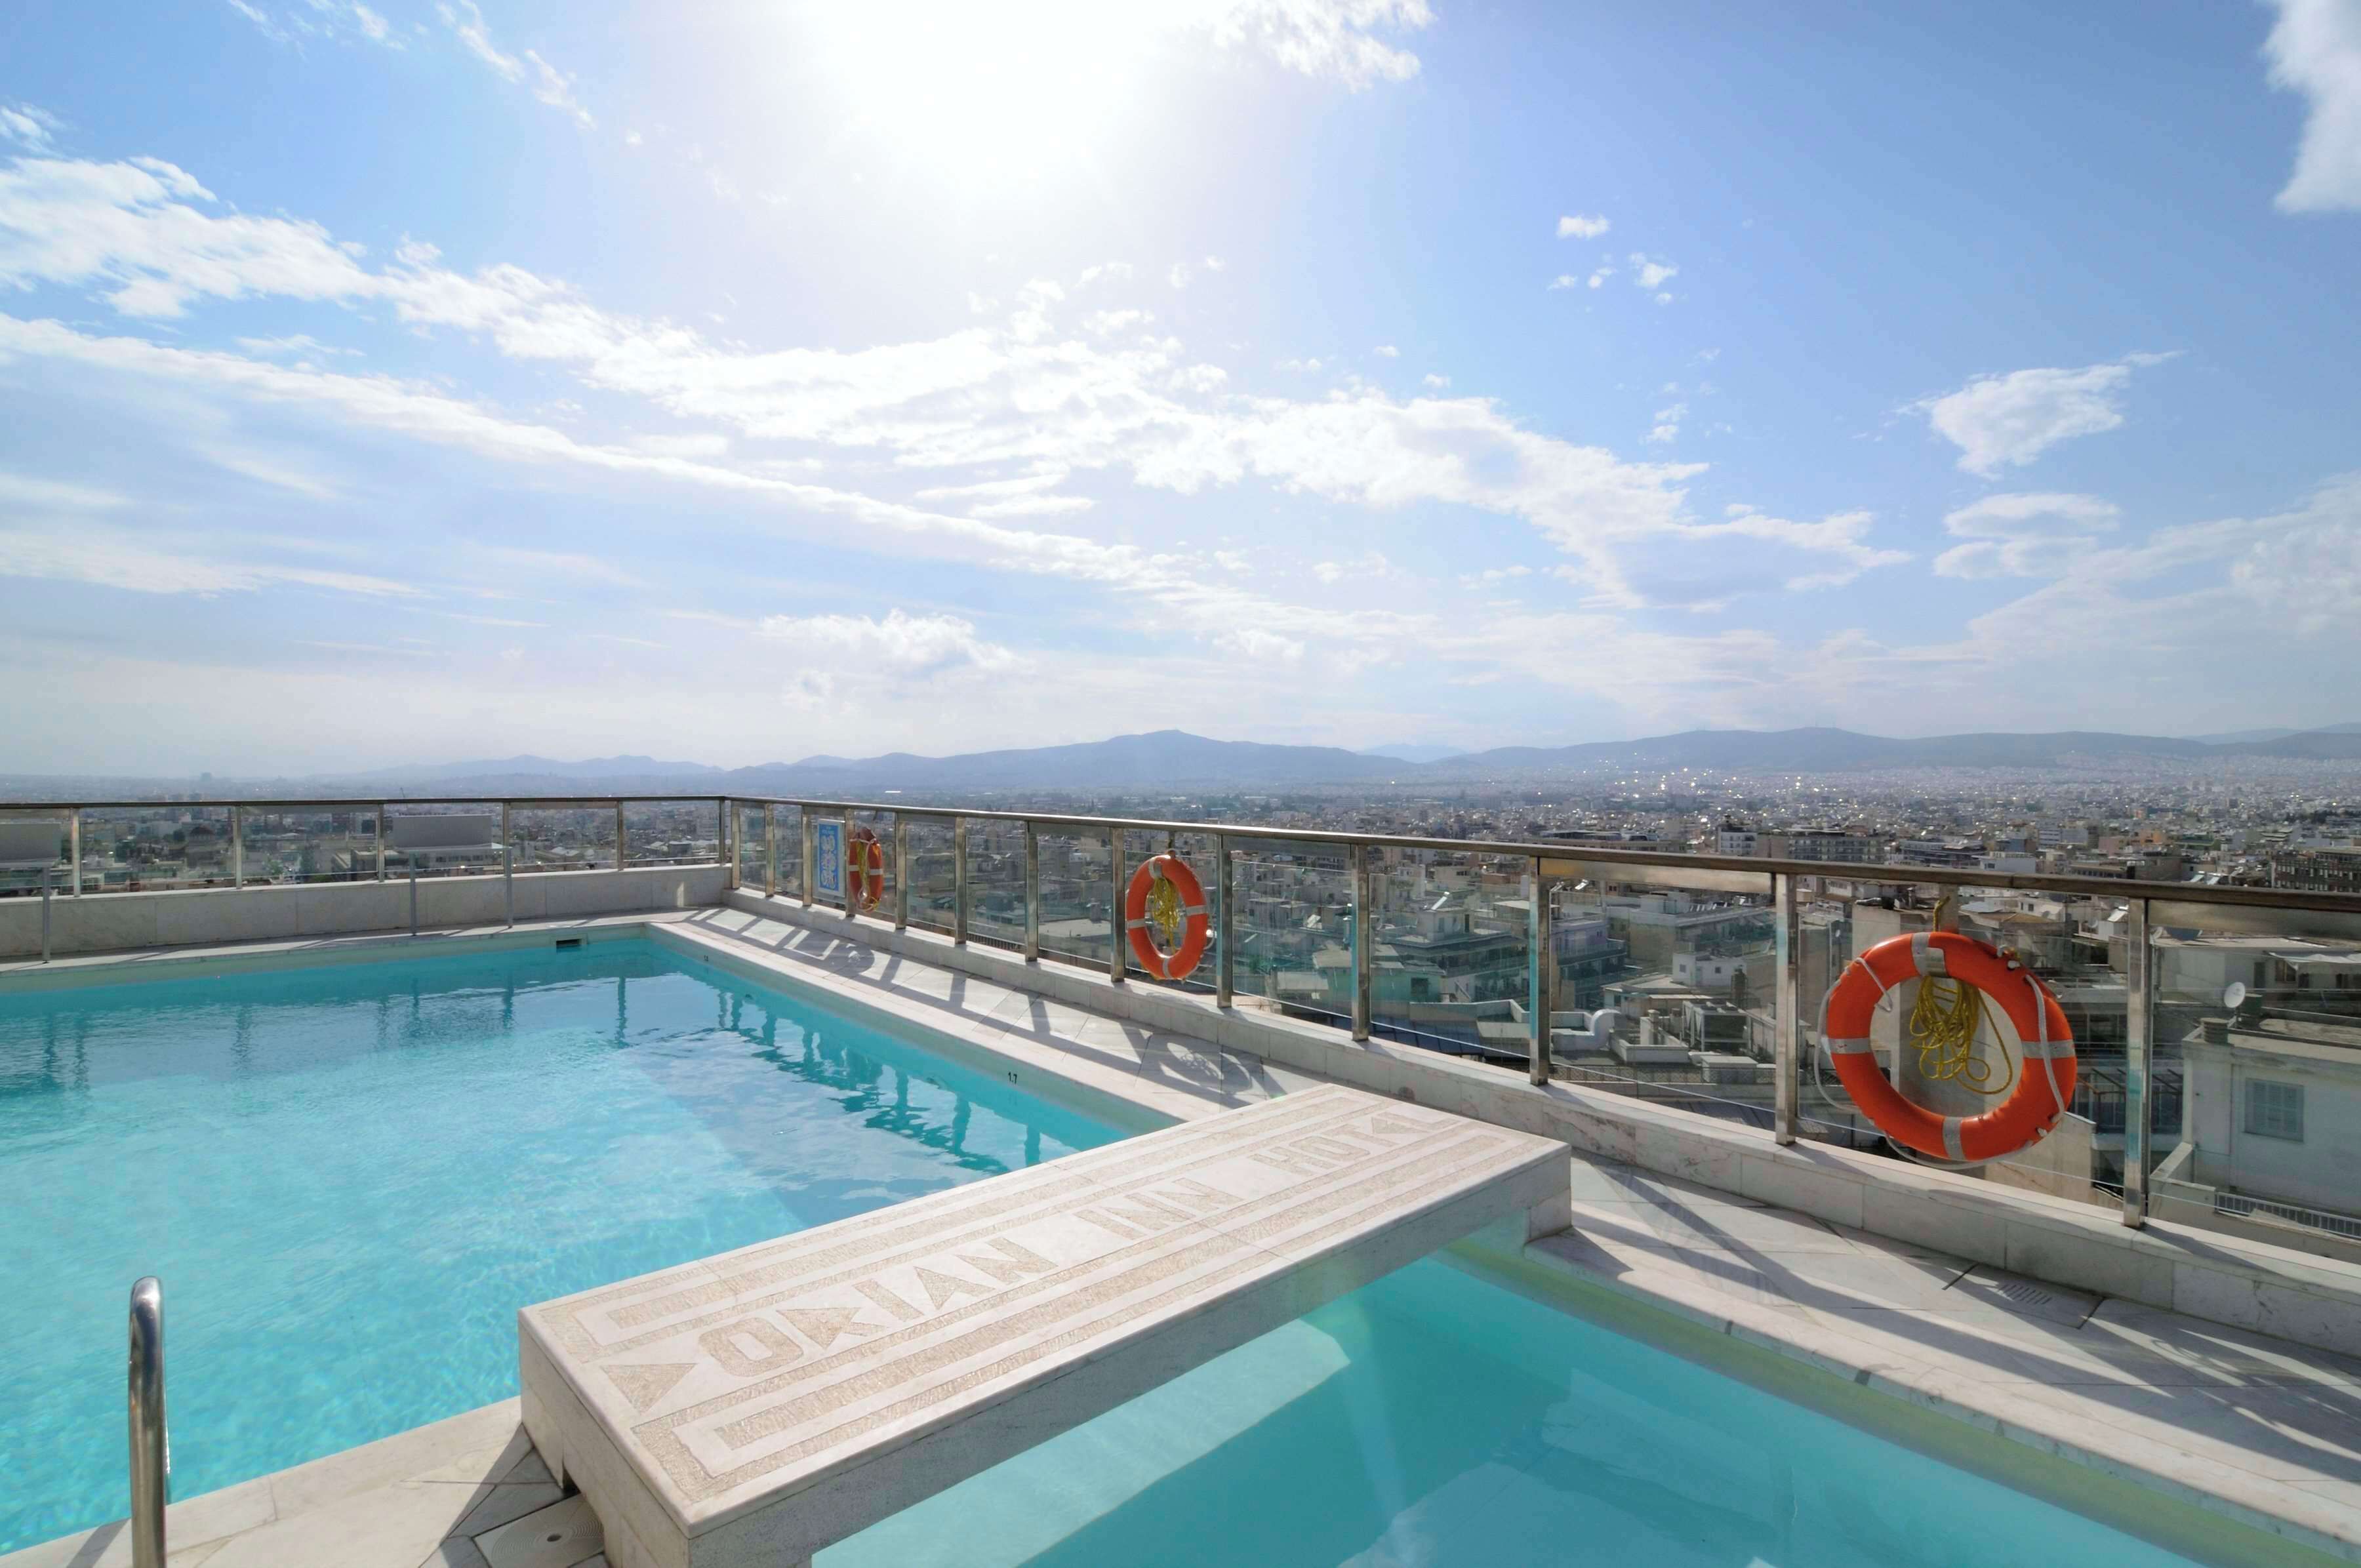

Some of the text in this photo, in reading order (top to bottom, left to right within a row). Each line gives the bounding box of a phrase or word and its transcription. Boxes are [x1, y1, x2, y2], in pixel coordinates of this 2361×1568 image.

[1007, 1071, 1018, 1085] 1.7
[1073, 1177, 1244, 1241] INN
[1249, 1112, 1460, 1177] HOTEL
